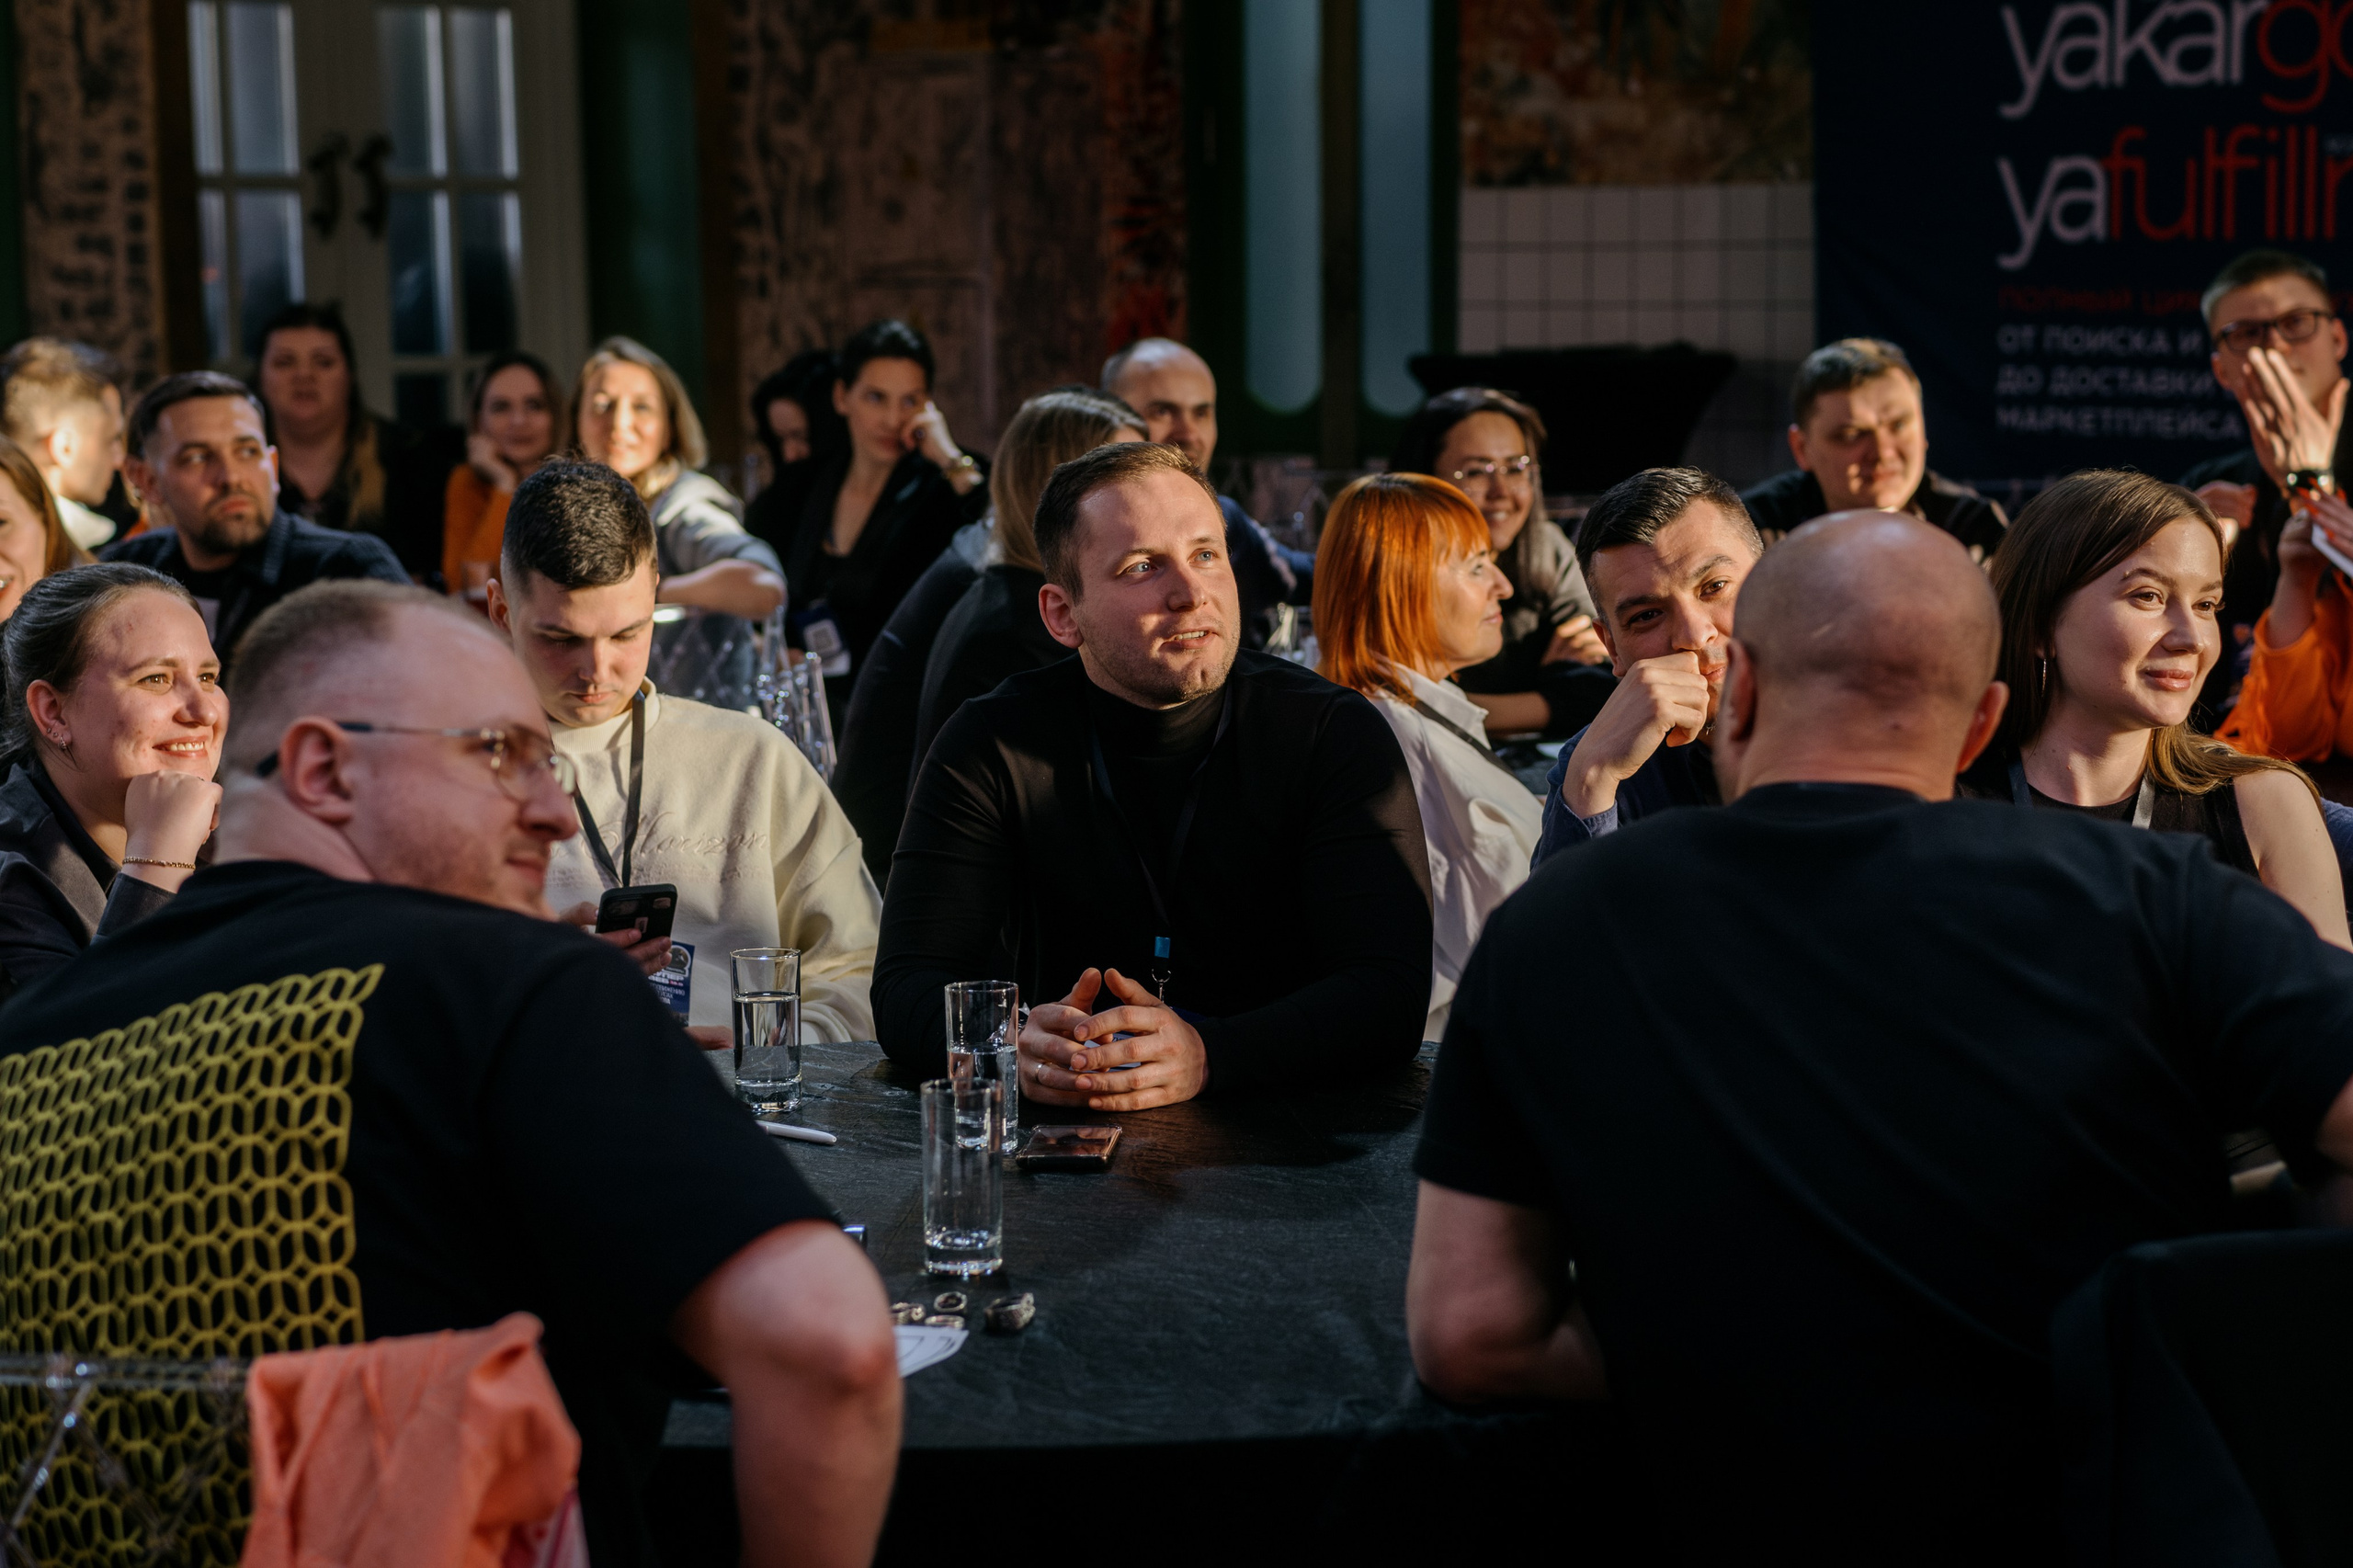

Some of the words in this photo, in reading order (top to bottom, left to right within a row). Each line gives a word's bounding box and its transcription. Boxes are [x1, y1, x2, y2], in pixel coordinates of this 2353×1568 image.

[1996, 0, 2353, 119] yakarg
[1996, 324, 2036, 356] ОТ
[2041, 324, 2173, 357] ПОИСКА
[1995, 363, 2045, 396] ДО
